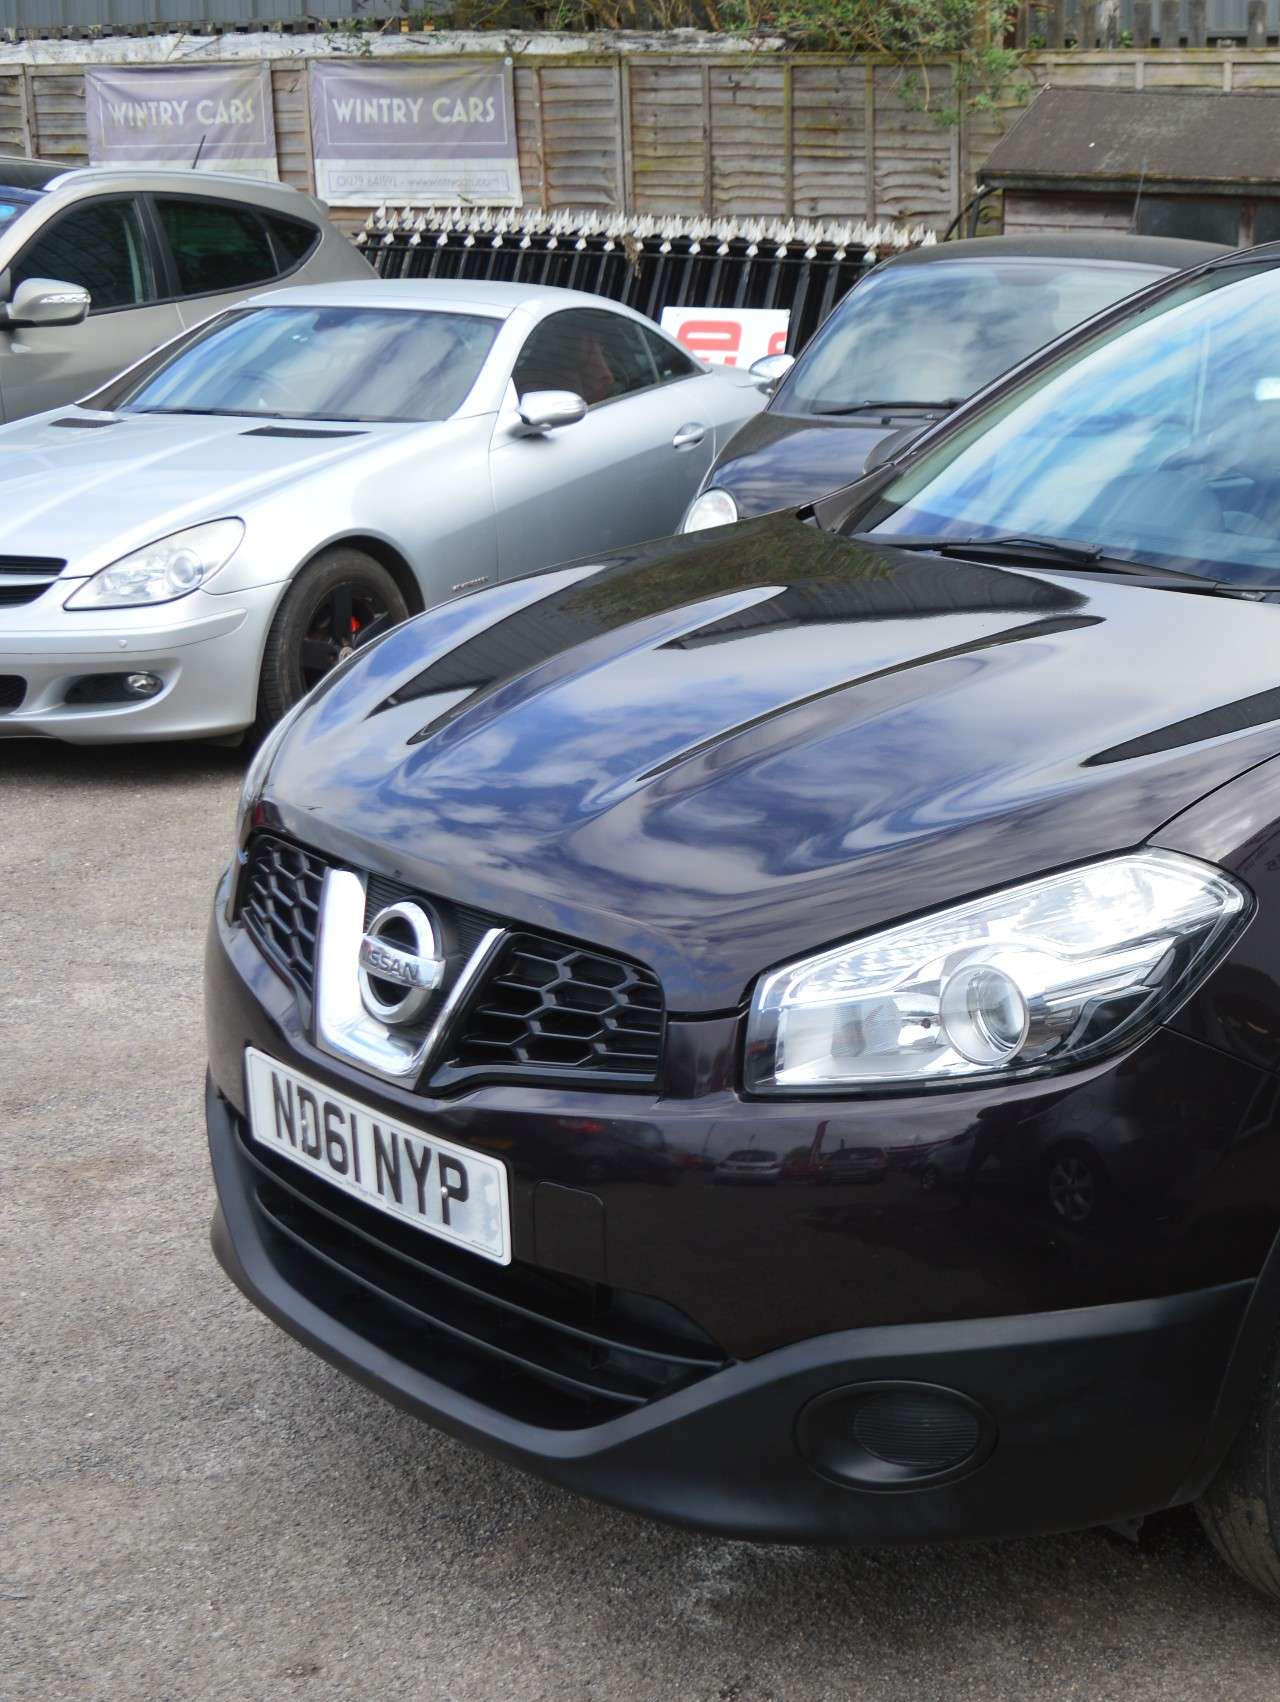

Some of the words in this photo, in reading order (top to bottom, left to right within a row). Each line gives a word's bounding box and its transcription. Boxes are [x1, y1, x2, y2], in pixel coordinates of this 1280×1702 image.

[107, 99, 189, 128] WINTRY
[196, 97, 256, 126] CARS
[332, 97, 424, 124] WINTRY
[431, 97, 497, 124] CARS
[362, 944, 420, 983] SSAN
[271, 1070, 362, 1185] ND61
[372, 1123, 469, 1226] NYP
